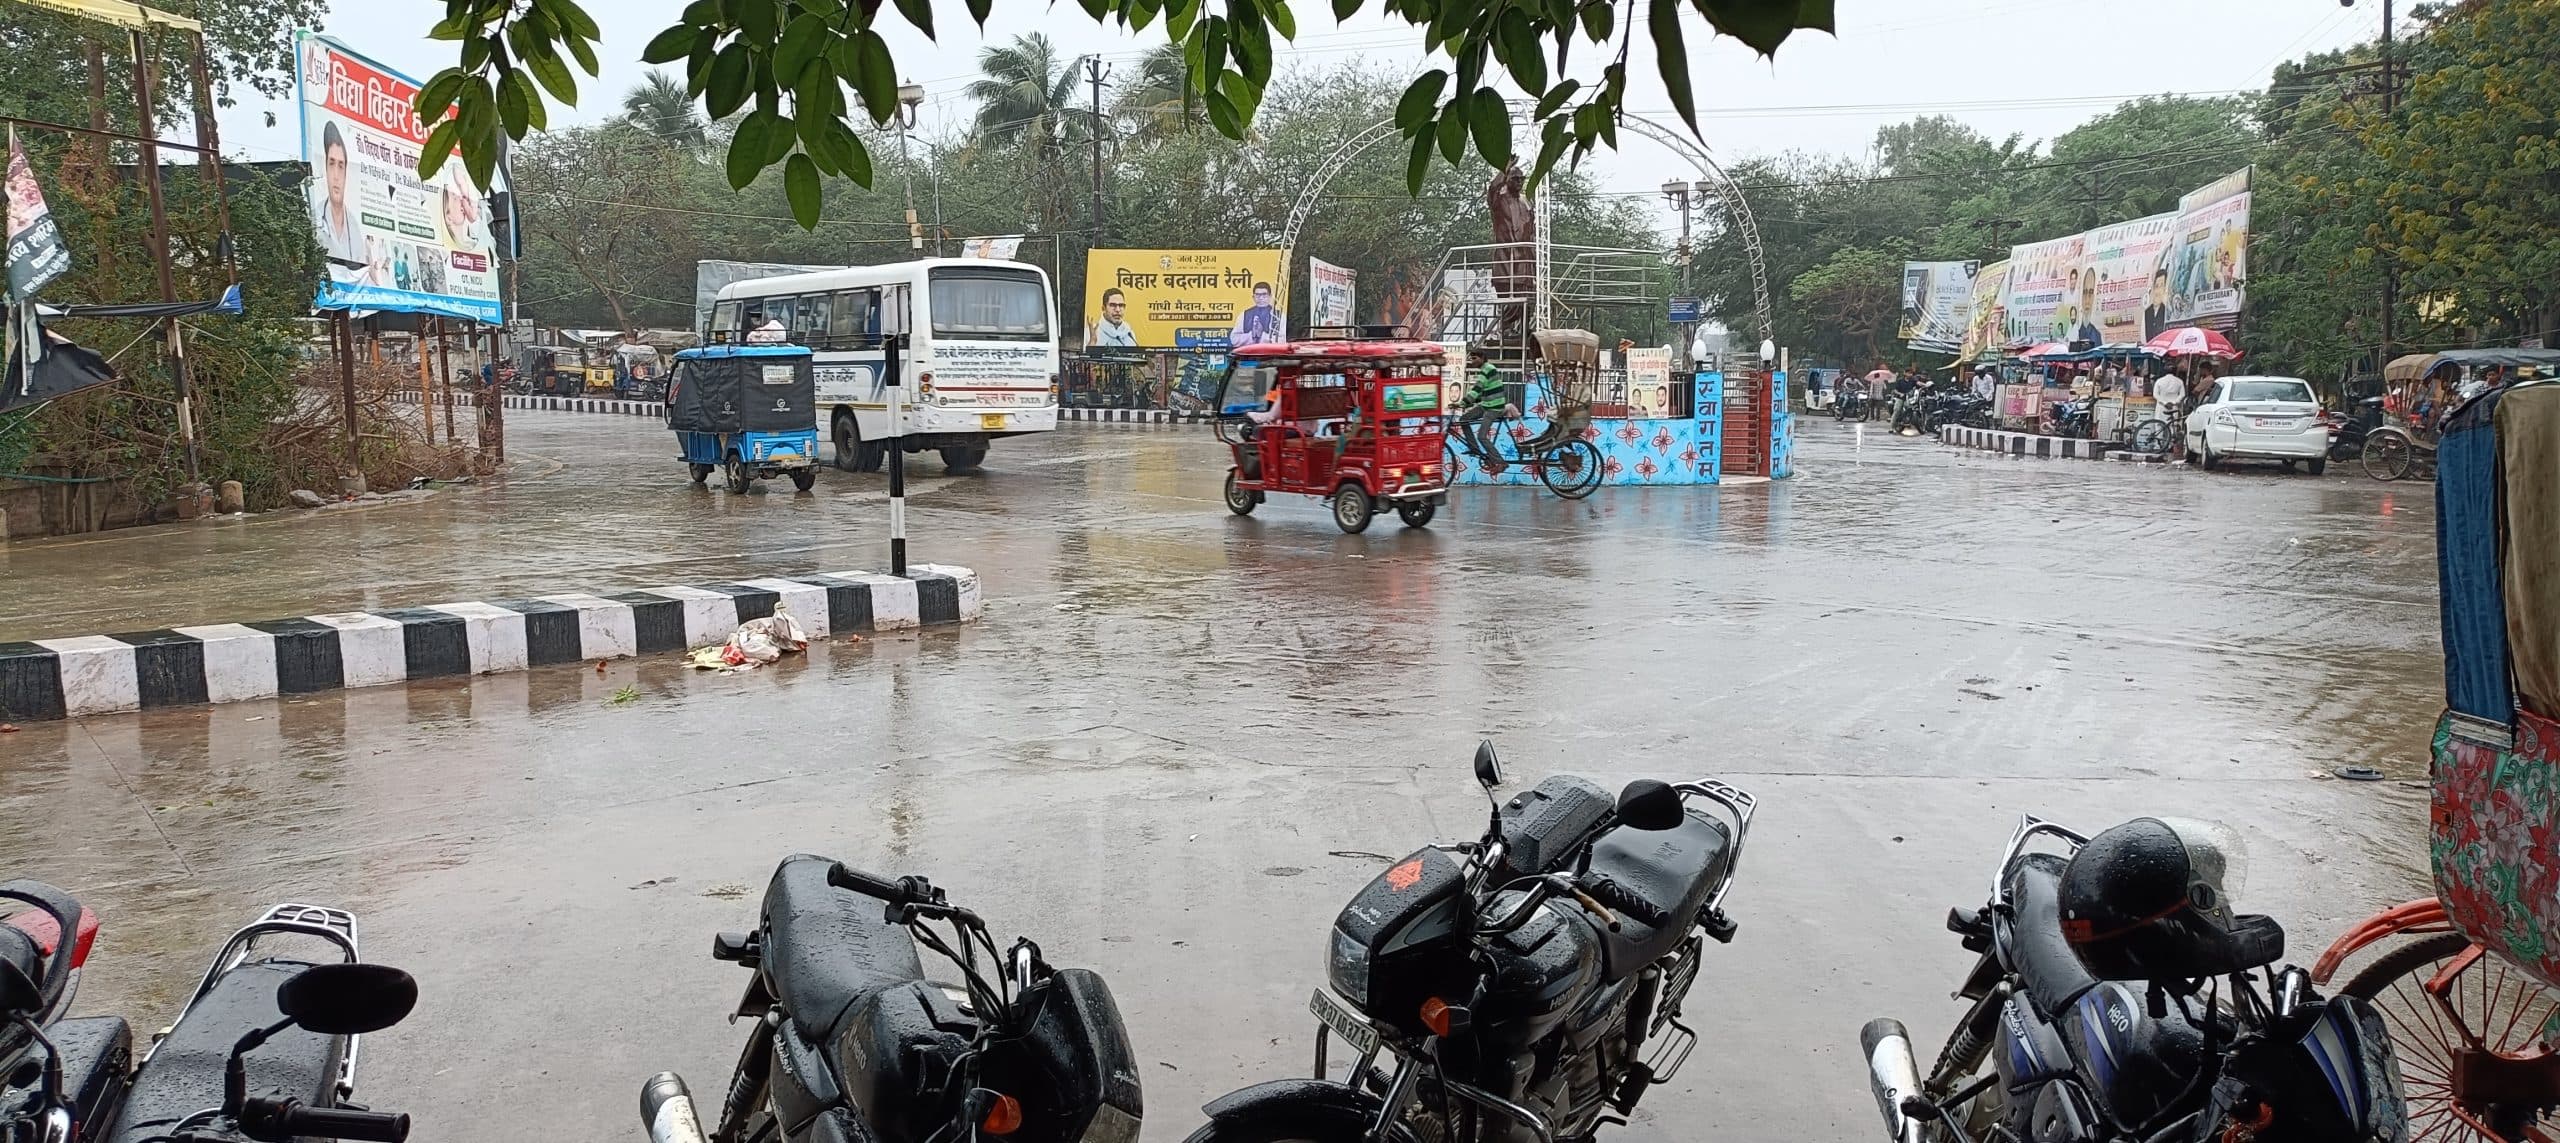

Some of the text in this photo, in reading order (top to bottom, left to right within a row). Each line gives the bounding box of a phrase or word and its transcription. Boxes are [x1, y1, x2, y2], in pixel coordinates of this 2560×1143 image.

[368, 77, 408, 134] विहार
[452, 253, 473, 270] Facility
[1177, 255, 1217, 266] जन सुराज
[1116, 266, 1253, 290] बिहार बदलाव रैली
[1148, 299, 1234, 311] गांधी मैदान, पटना
[1020, 396, 1041, 404] TATA
